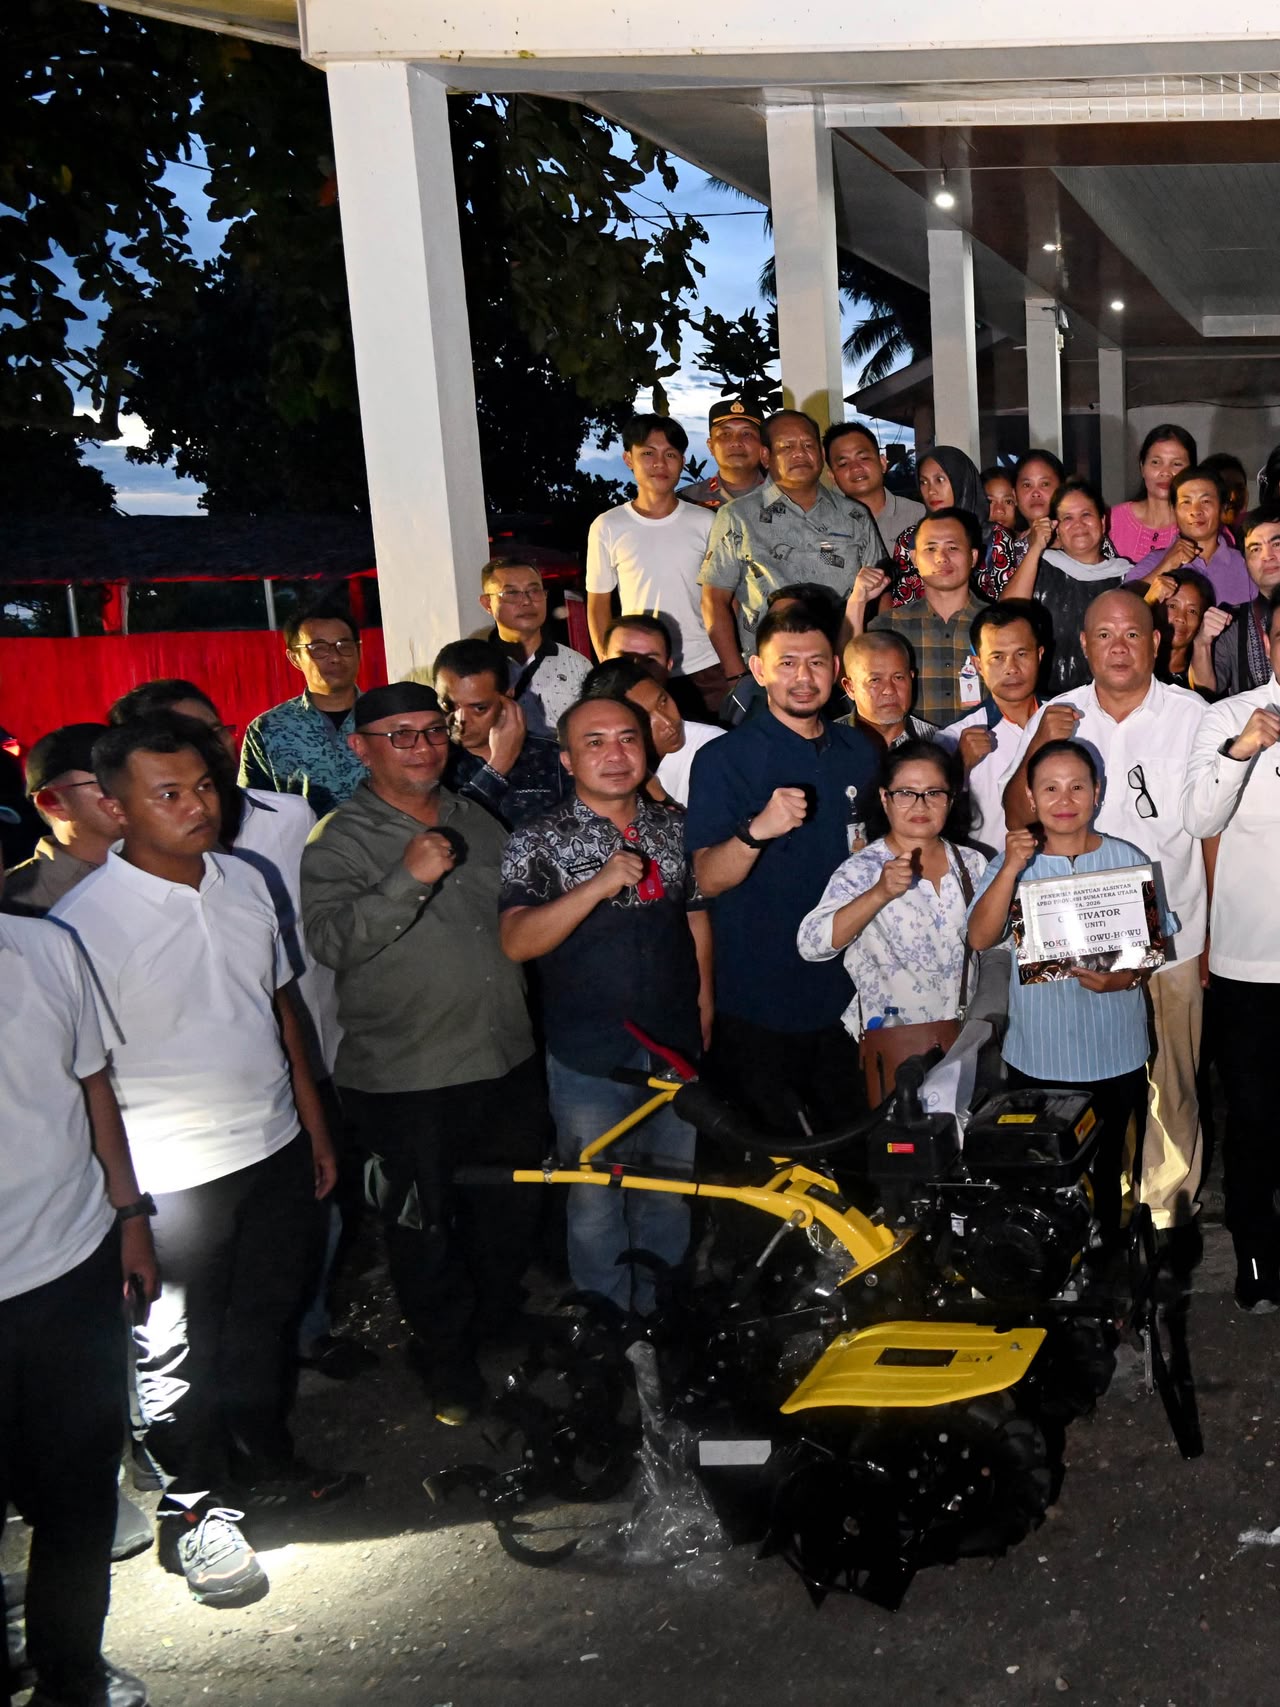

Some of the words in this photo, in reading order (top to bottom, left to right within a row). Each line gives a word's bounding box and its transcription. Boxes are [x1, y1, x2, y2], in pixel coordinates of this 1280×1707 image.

[1073, 887, 1101, 896] BANTUAN
[1102, 883, 1132, 892] ALSINTAN
[1083, 892, 1116, 901] SUMATERA
[1117, 888, 1138, 897] UTARA
